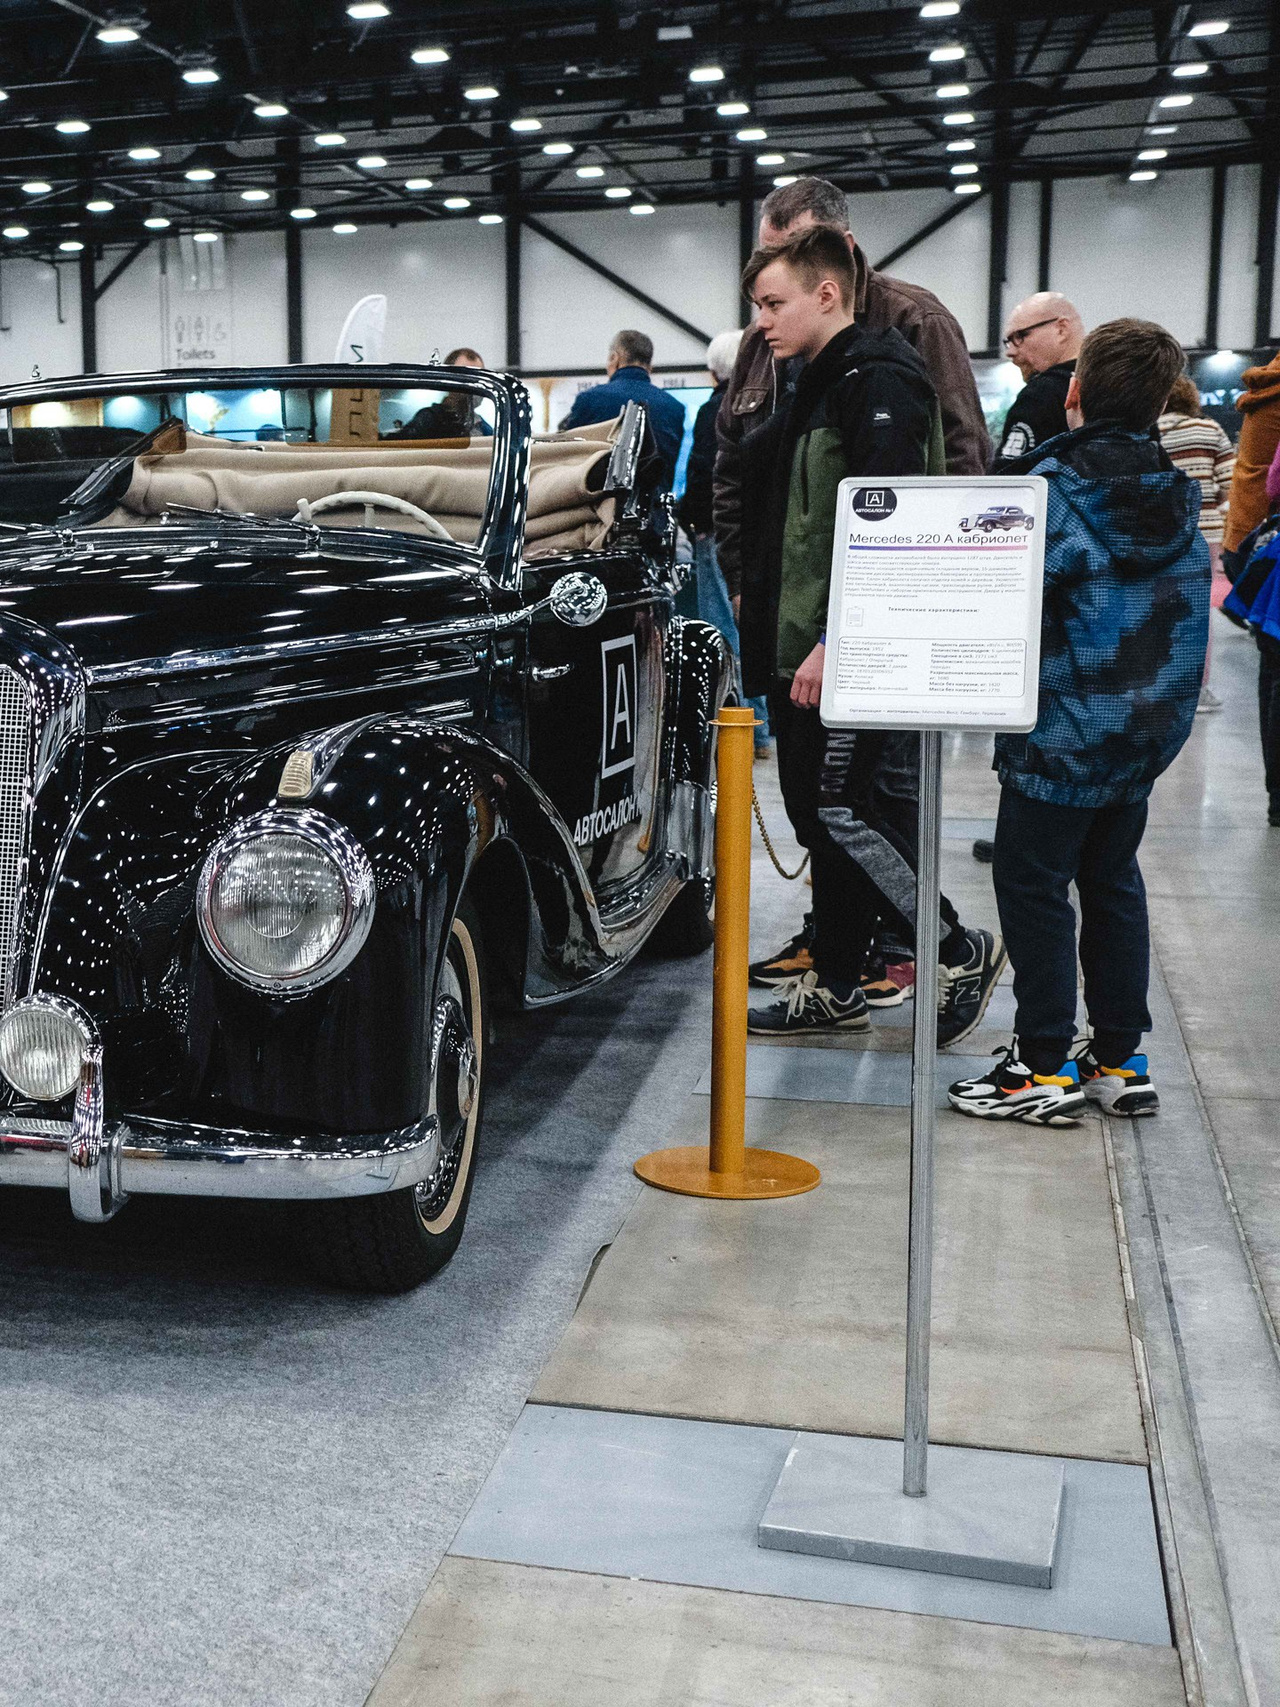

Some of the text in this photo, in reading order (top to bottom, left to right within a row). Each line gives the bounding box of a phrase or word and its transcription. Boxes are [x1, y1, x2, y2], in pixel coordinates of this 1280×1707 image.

[849, 533, 912, 544] Mercedes
[916, 534, 941, 544] 220
[957, 534, 1028, 546] кабриолет
